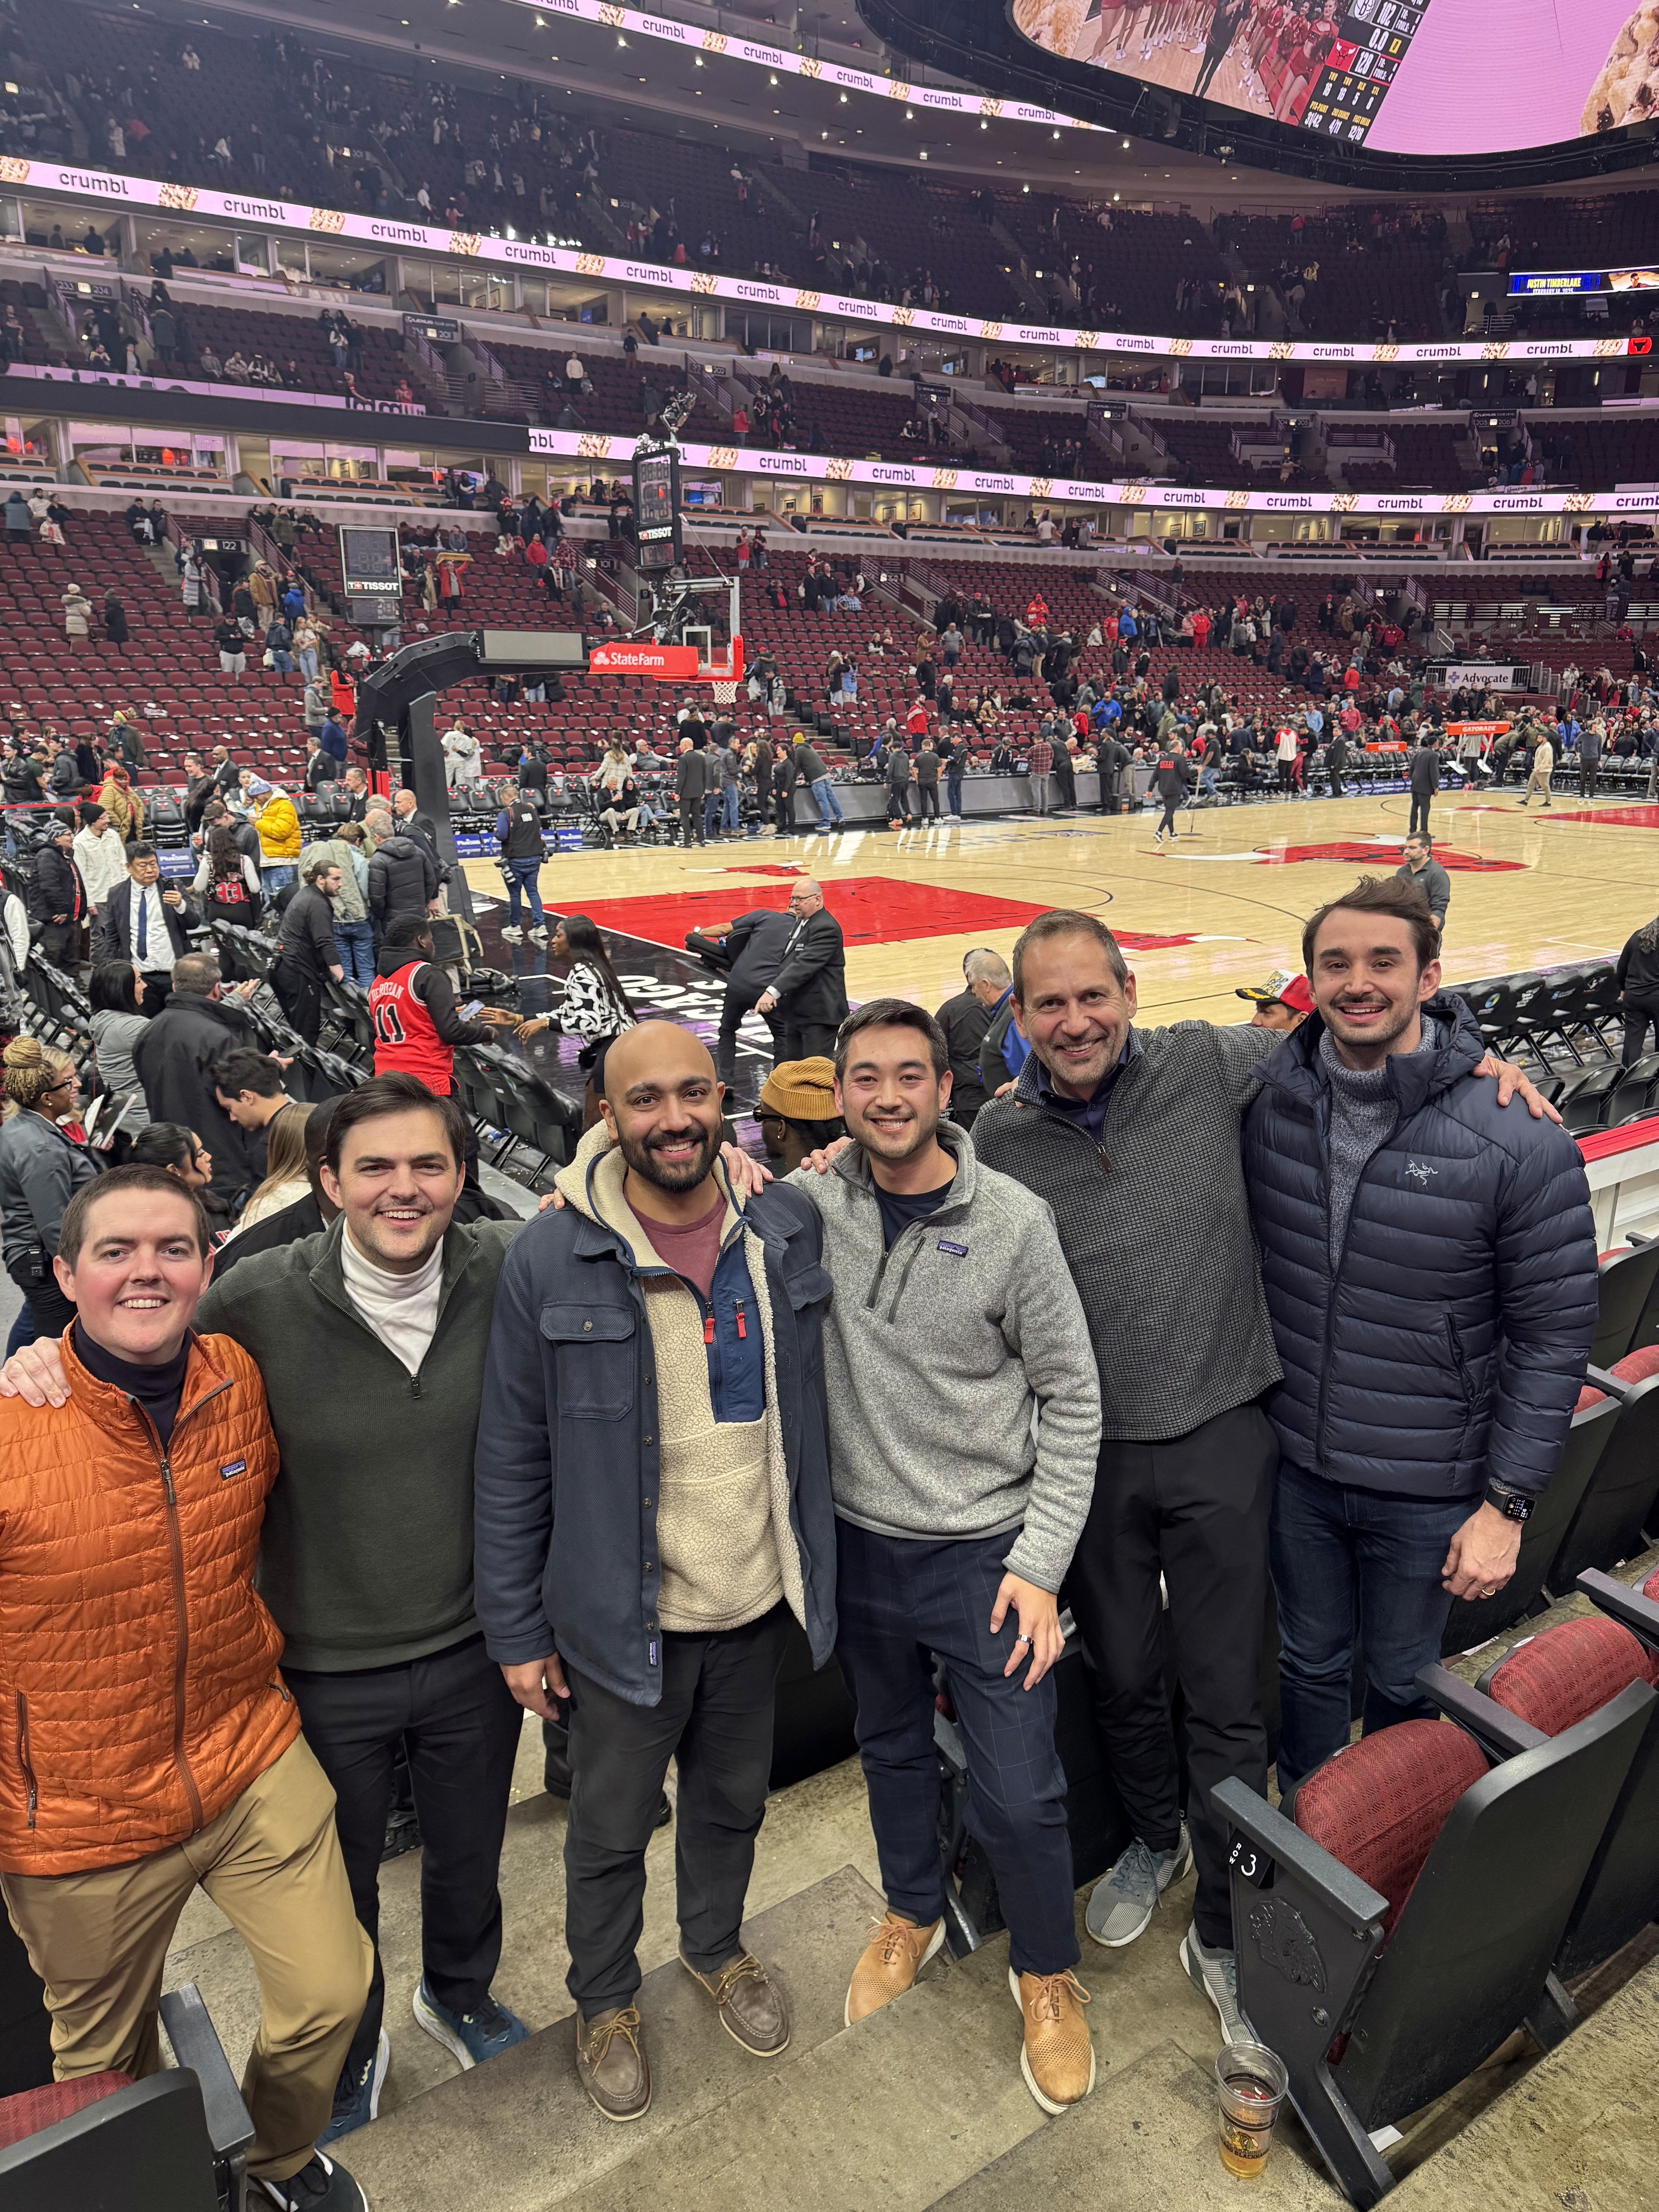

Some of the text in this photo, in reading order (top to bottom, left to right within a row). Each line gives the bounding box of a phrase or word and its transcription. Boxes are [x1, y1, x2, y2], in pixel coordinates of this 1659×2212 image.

[1377, 2, 1397, 27] 102
[1369, 28, 1389, 51] 0.0
[536, 0, 1056, 120] umbl crumbl crumbl crumbl crumbl crumbl
[1354, 51, 1374, 75] 128
[60, 173, 1573, 357] crumbl crumbl crumbl crumbl crumbl crumbl crumbl crumbl crumbl crumbl crumbl crumbl crumbl crumbl
[1527, 277, 1582, 289] JUSTIN TIMBERLAKE
[759, 457, 807, 472] crumbl
[872, 468, 915, 482] crumbl
[975, 477, 1014, 490] crumbl
[1068, 486, 1105, 498] crumbl
[1164, 492, 1206, 503] crumbl
[1267, 496, 1312, 507] crumbl
[1378, 498, 1423, 509] crumbl
[1493, 497, 1543, 508] crumbl
[647, 527, 672, 539] TISSOT
[222, 541, 236, 550] 122
[361, 581, 399, 591] TISSOT
[1462, 673, 1508, 683] Advocate
[1462, 725, 1496, 733] GATORADE
[215, 882, 244, 904] 33
[371, 982, 404, 1002] DEROZAN
[375, 1003, 406, 1044] 11
[939, 1245, 963, 1255] patagonia
[1229, 1842, 1242, 1865] ROW
[1241, 1854, 1257, 1876] 3
